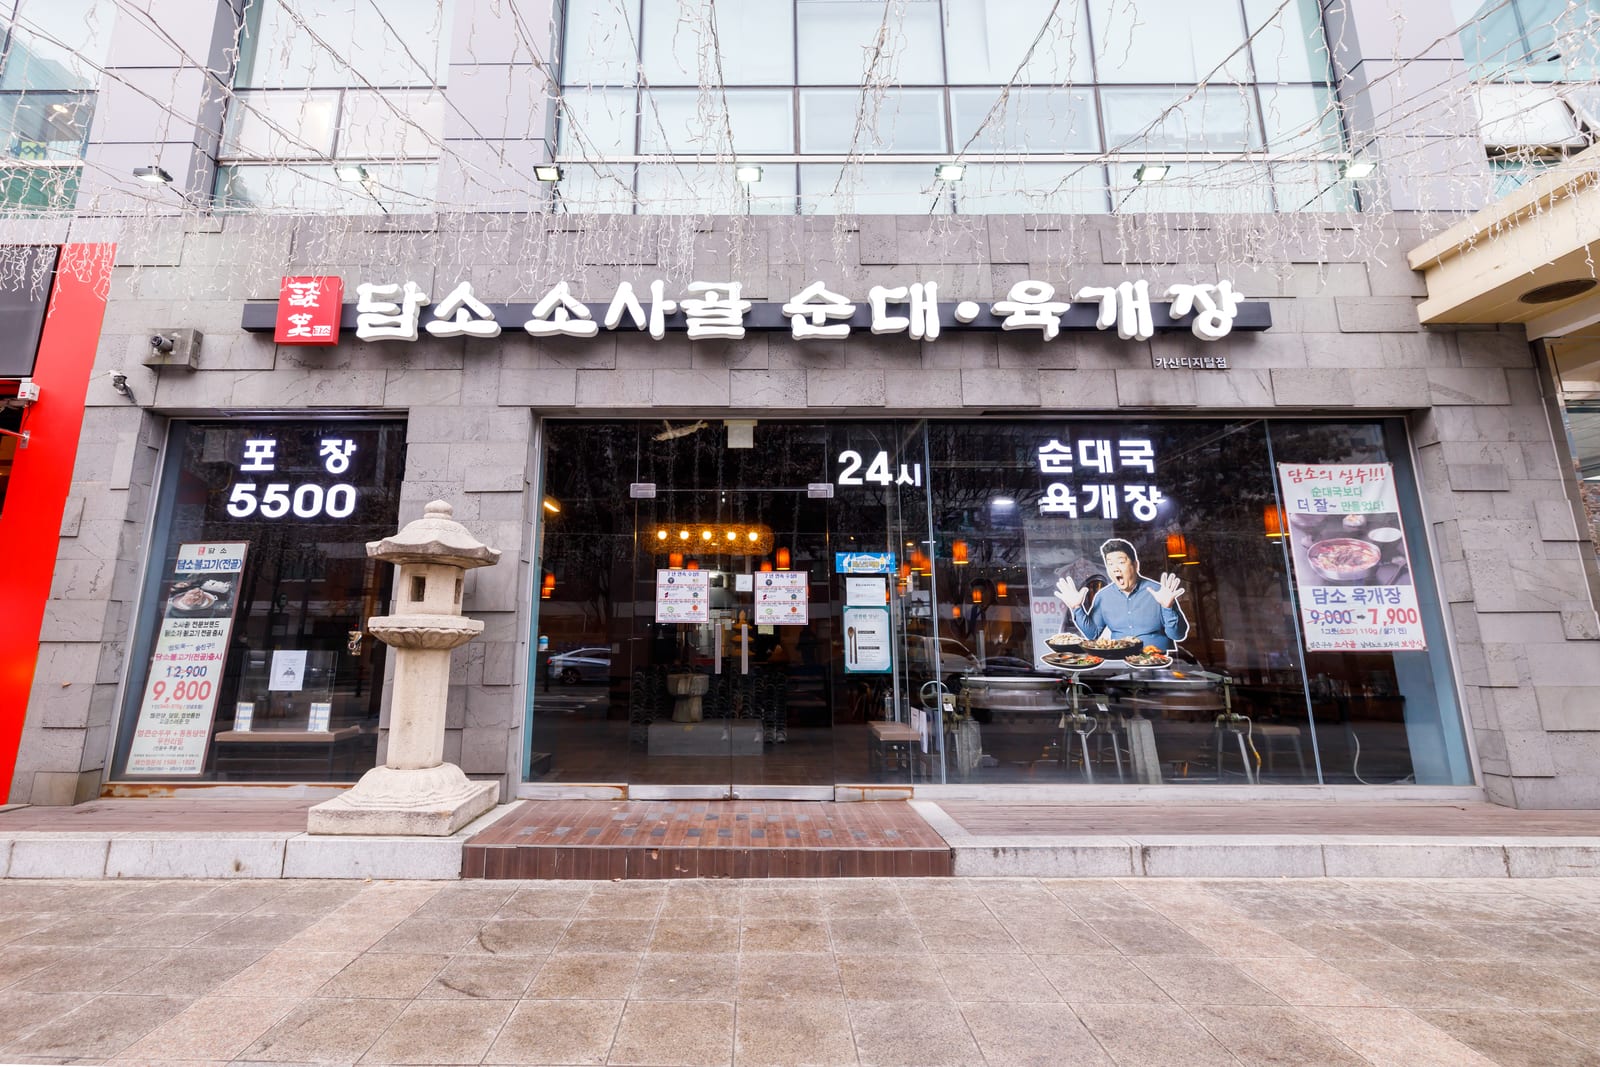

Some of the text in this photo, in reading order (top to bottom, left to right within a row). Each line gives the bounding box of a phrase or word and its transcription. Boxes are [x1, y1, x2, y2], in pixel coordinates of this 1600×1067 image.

[356, 281, 501, 342] 담소
[524, 280, 752, 341] 소사골
[1156, 357, 1227, 369] 가산디지털점
[1038, 440, 1155, 474] 순대국
[838, 450, 922, 487] 24시
[1287, 467, 1385, 485] 담소의 실수!!!
[226, 483, 357, 518] 5500
[1037, 482, 1167, 522] 육개장
[1310, 486, 1363, 498] 순대국보다
[1297, 498, 1310, 512] 더
[1311, 586, 1402, 606] 담소 육개장
[1310, 607, 1418, 627] 9,000 7,900
[165, 665, 208, 679] 12,900
[152, 680, 212, 703] 9,800
